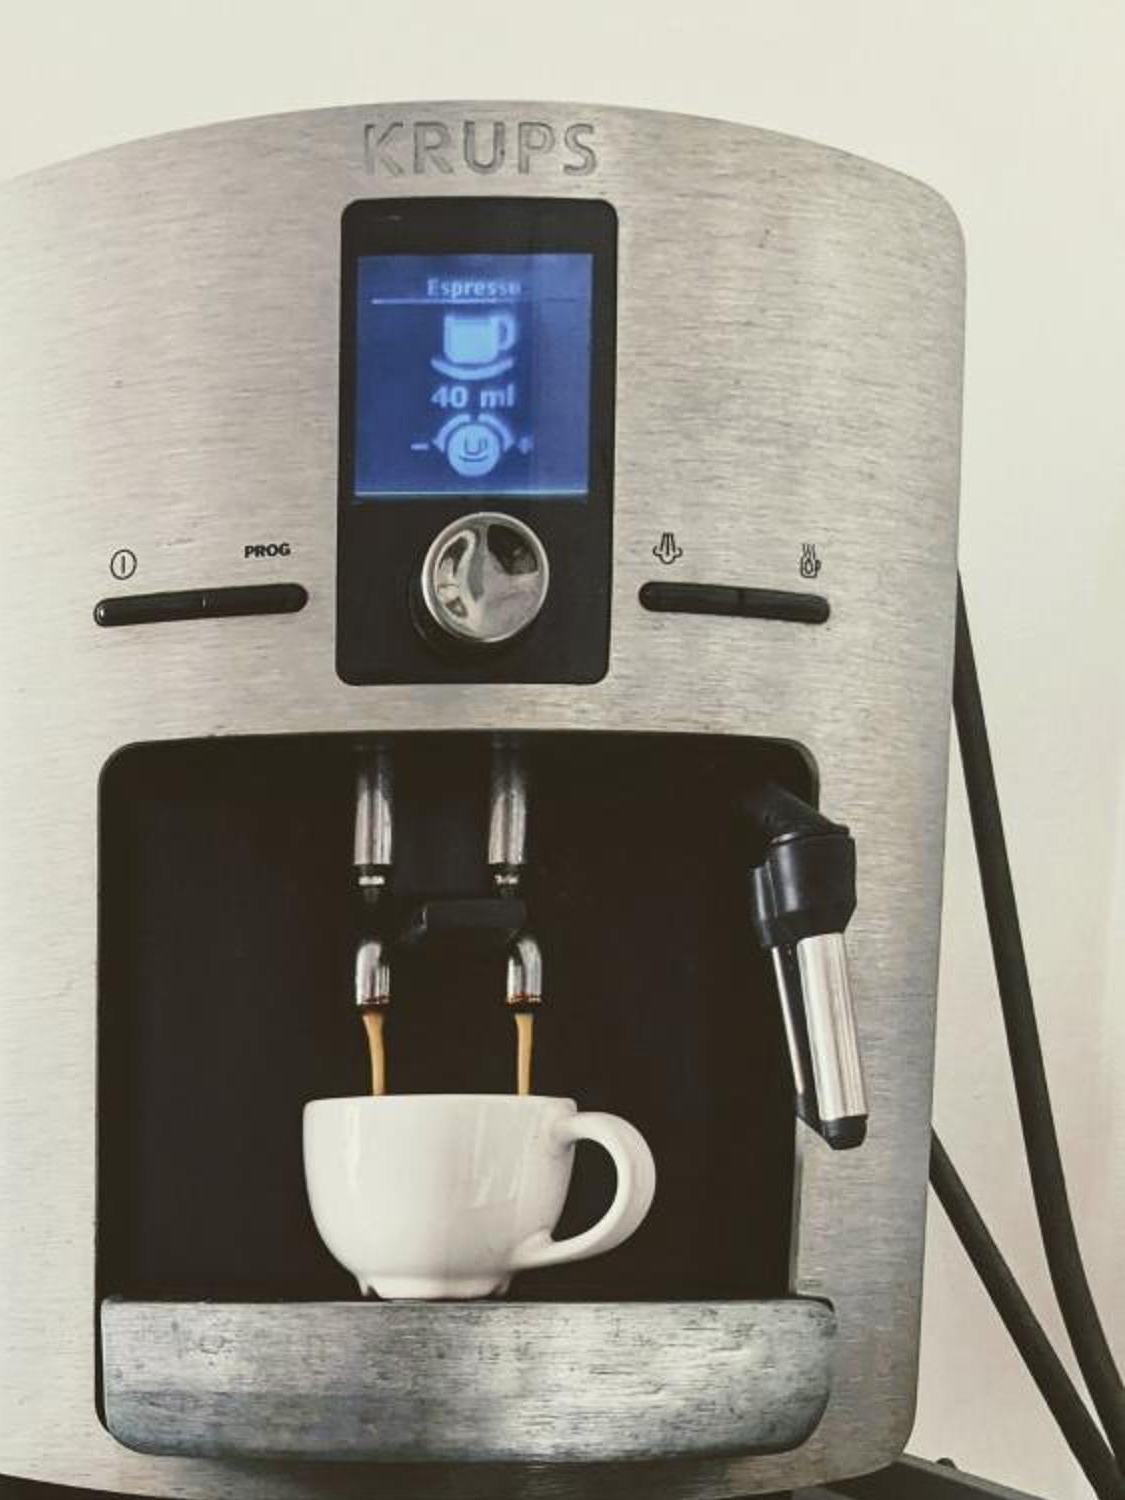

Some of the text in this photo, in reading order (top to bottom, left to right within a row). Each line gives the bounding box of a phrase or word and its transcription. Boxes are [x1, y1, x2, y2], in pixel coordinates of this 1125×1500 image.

[364, 120, 598, 175] KRUPS
[427, 278, 522, 299] Espresso
[431, 383, 515, 408] 40 ml
[244, 543, 291, 559] PROG
